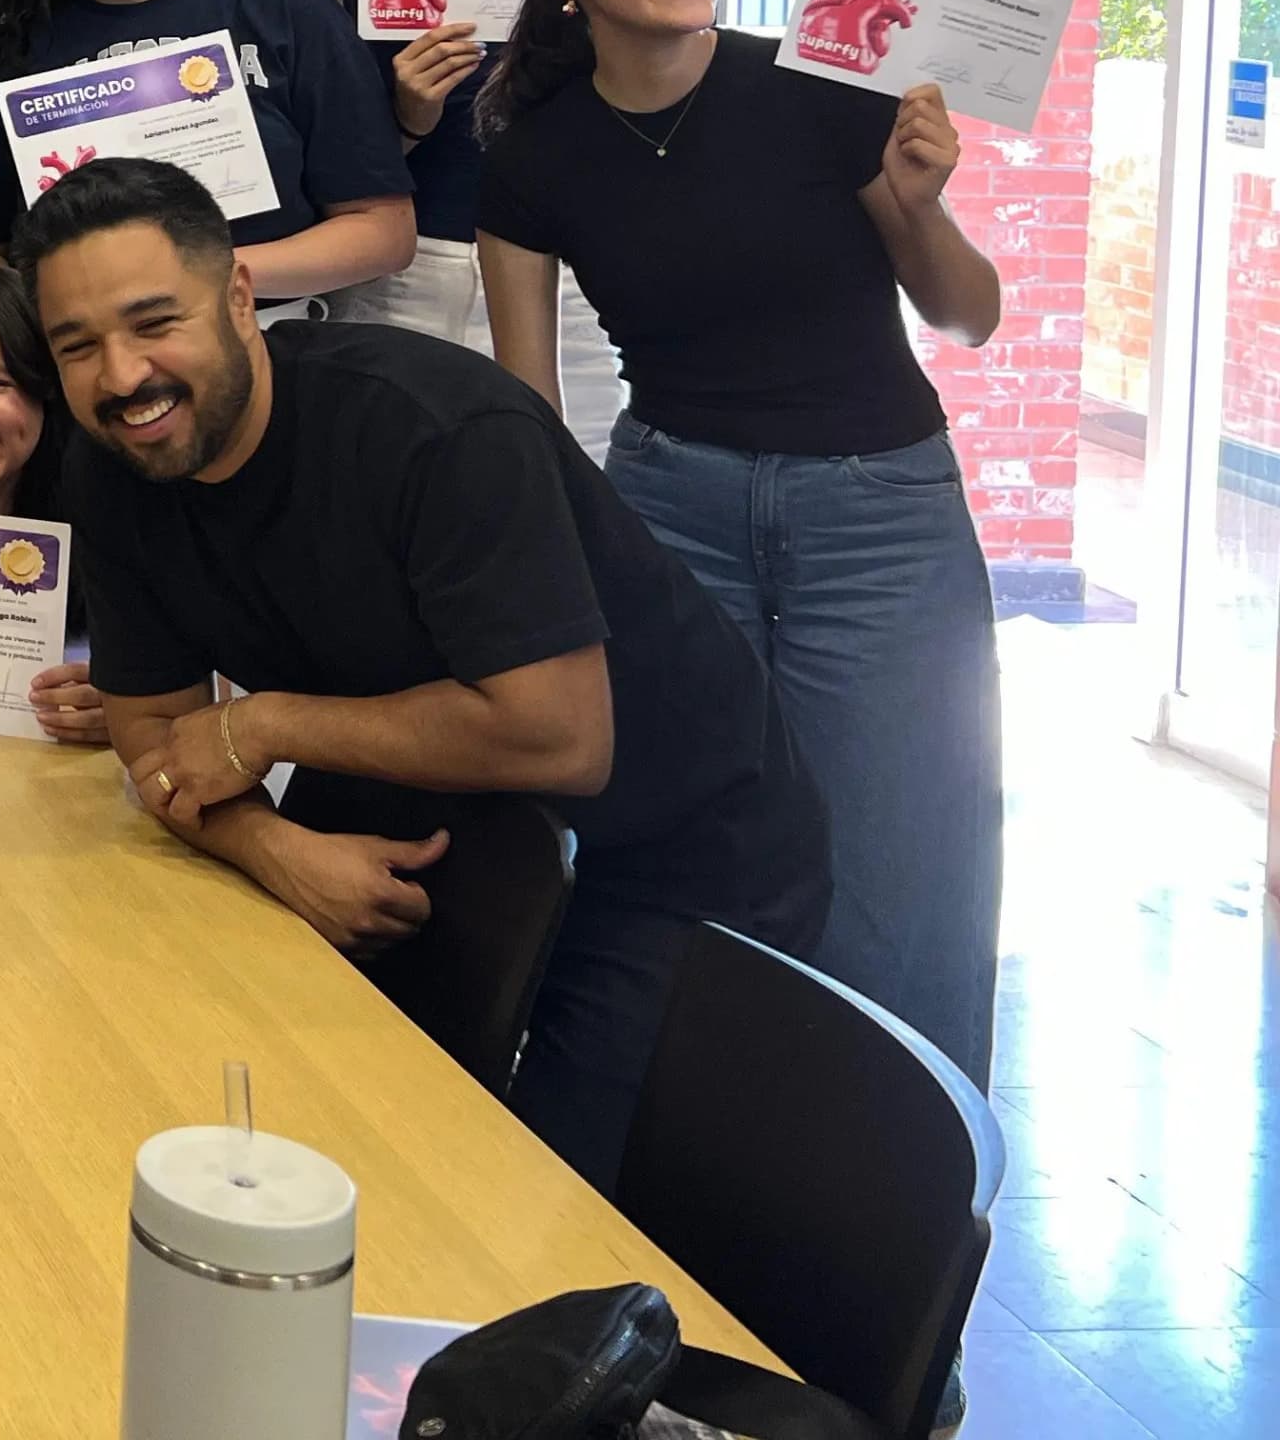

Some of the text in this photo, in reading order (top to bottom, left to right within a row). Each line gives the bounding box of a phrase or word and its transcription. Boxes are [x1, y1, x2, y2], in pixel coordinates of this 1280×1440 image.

[369, 7, 424, 21] Superfy
[797, 31, 861, 60] Superfy
[20, 76, 135, 115] CERTIFICADO
[25, 100, 109, 126] DE TERMINACIÓN
[144, 129, 170, 139] Adriana
[10, 614, 37, 624] Robles
